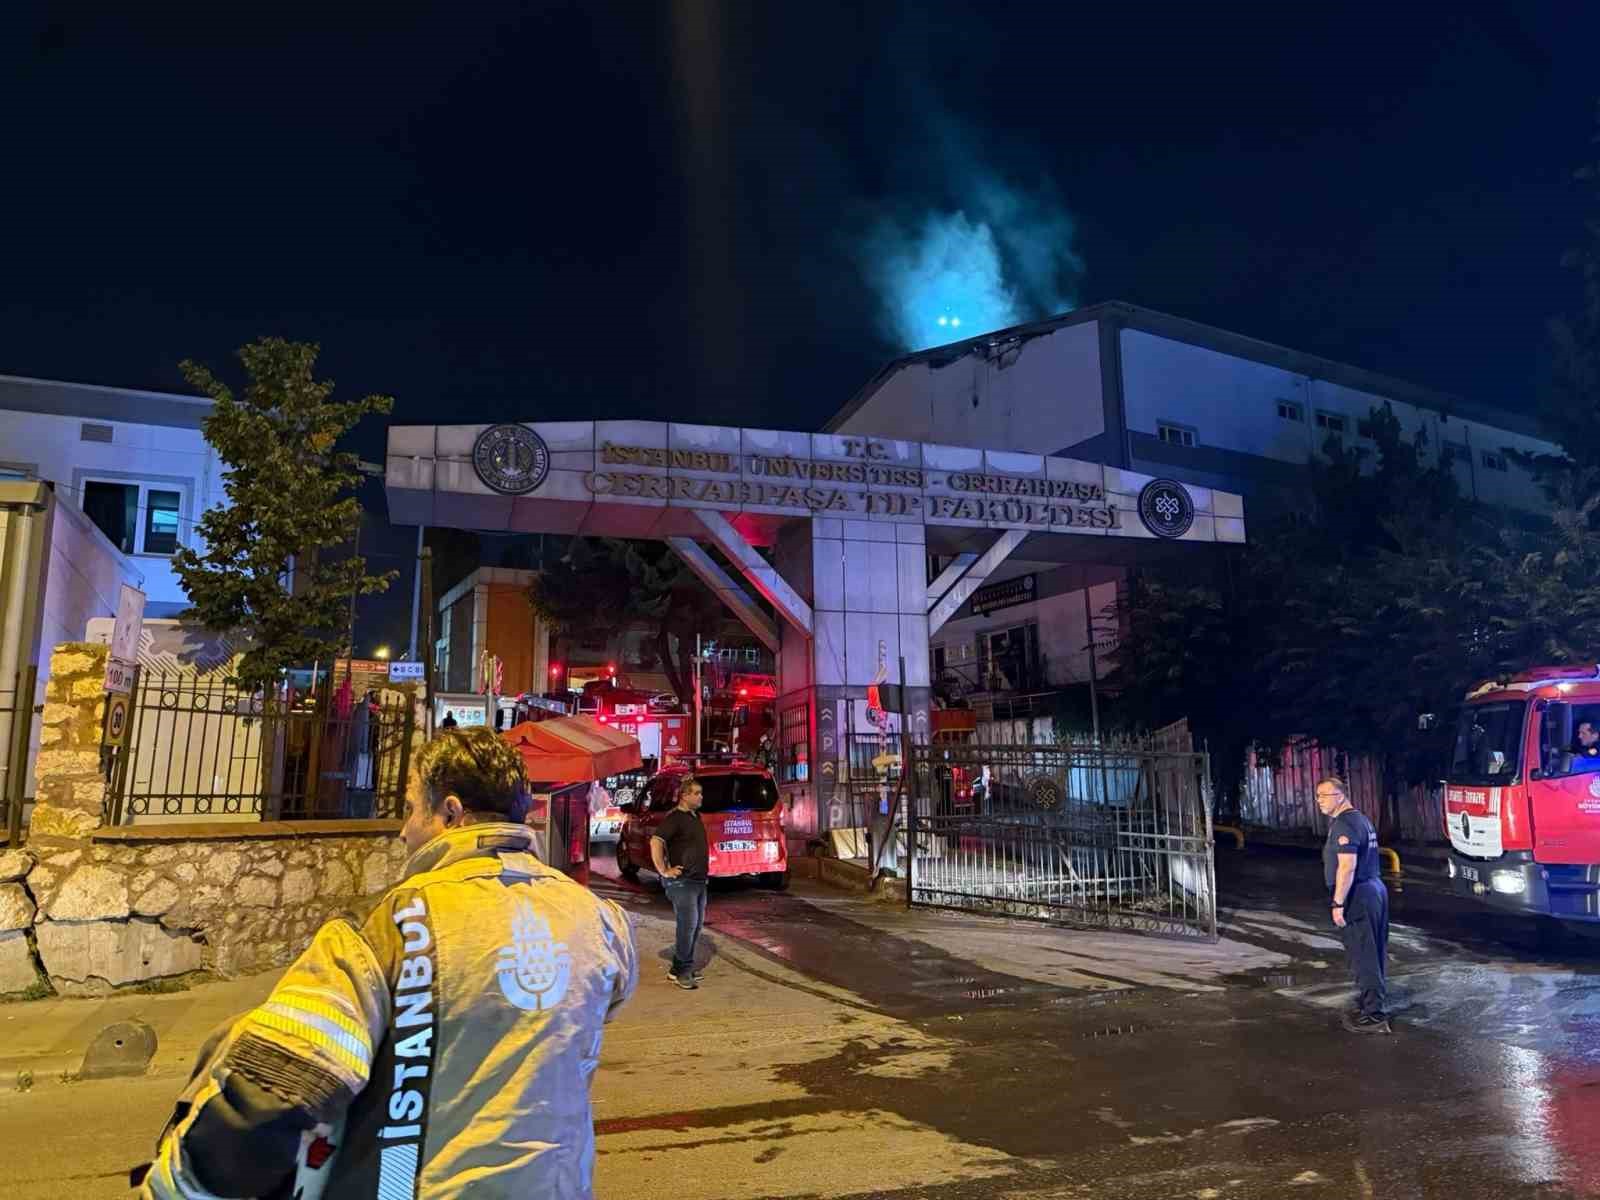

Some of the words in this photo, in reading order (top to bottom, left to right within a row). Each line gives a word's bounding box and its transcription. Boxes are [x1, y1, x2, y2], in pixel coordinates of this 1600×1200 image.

[601, 441, 739, 472] İSTANBUL
[947, 473, 1105, 503] CERRAHPAŞA
[842, 440, 889, 459] T.C.
[584, 472, 855, 512] CERRAHPAŞA
[930, 496, 1122, 528] FAKÜLTESİ
[109, 669, 123, 686] 100
[377, 896, 433, 1139] İSTANBUL
